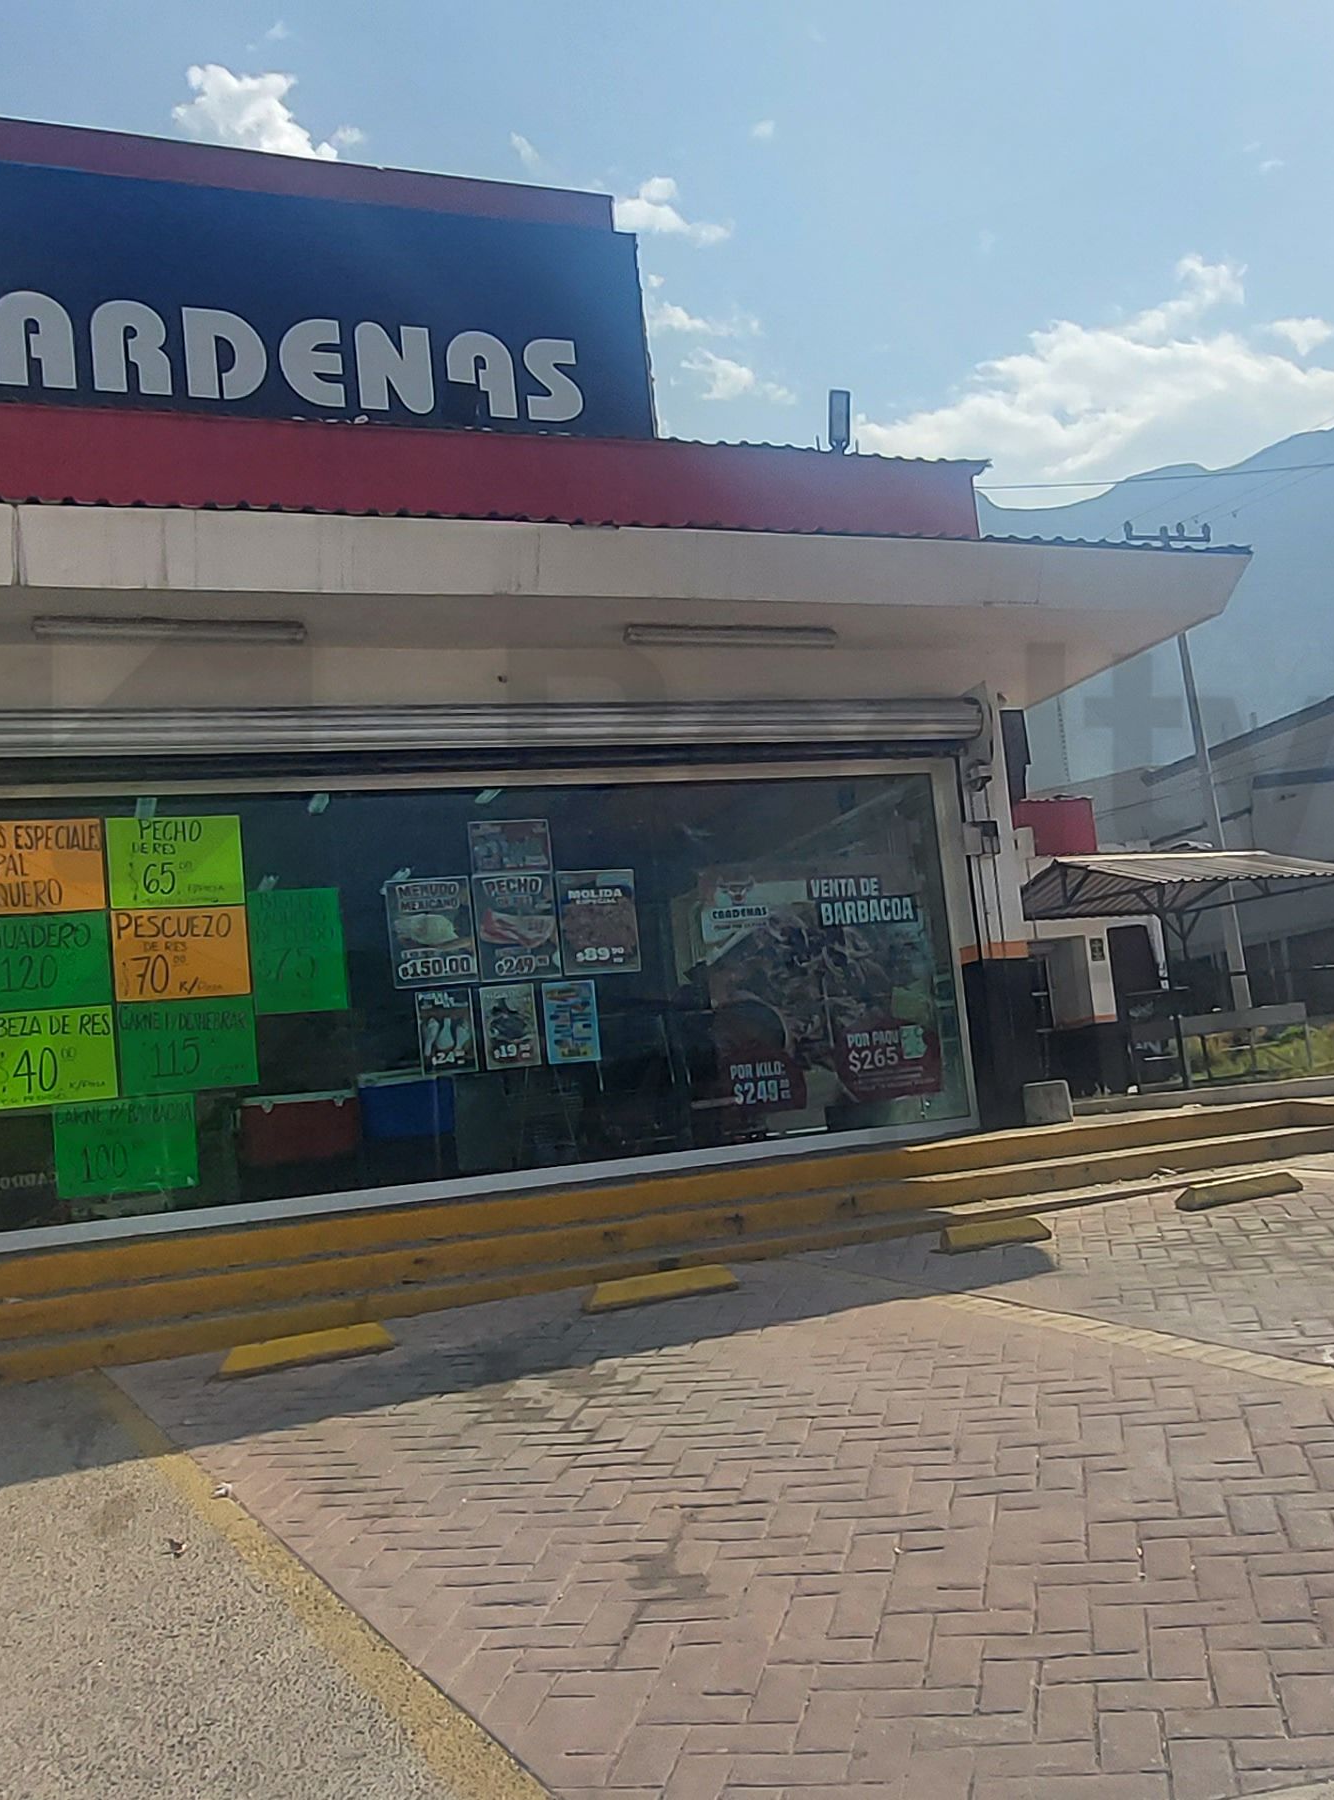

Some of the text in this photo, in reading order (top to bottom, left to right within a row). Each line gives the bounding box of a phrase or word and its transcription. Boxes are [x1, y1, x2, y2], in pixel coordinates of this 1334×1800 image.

[138, 818, 203, 843] PECHO
[131, 842, 151, 854] DE
[484, 877, 541, 896] PECHO
[567, 888, 623, 900] MOLIDA
[810, 877, 880, 898] VENTA DE
[820, 897, 914, 927] BARBACOA
[115, 911, 232, 940] PESCUEZO
[49, 1014, 72, 1036] DE
[78, 1012, 111, 1036] RES
[845, 1031, 870, 1049] POR
[847, 1046, 899, 1074] $265
[729, 1062, 754, 1081] POR
